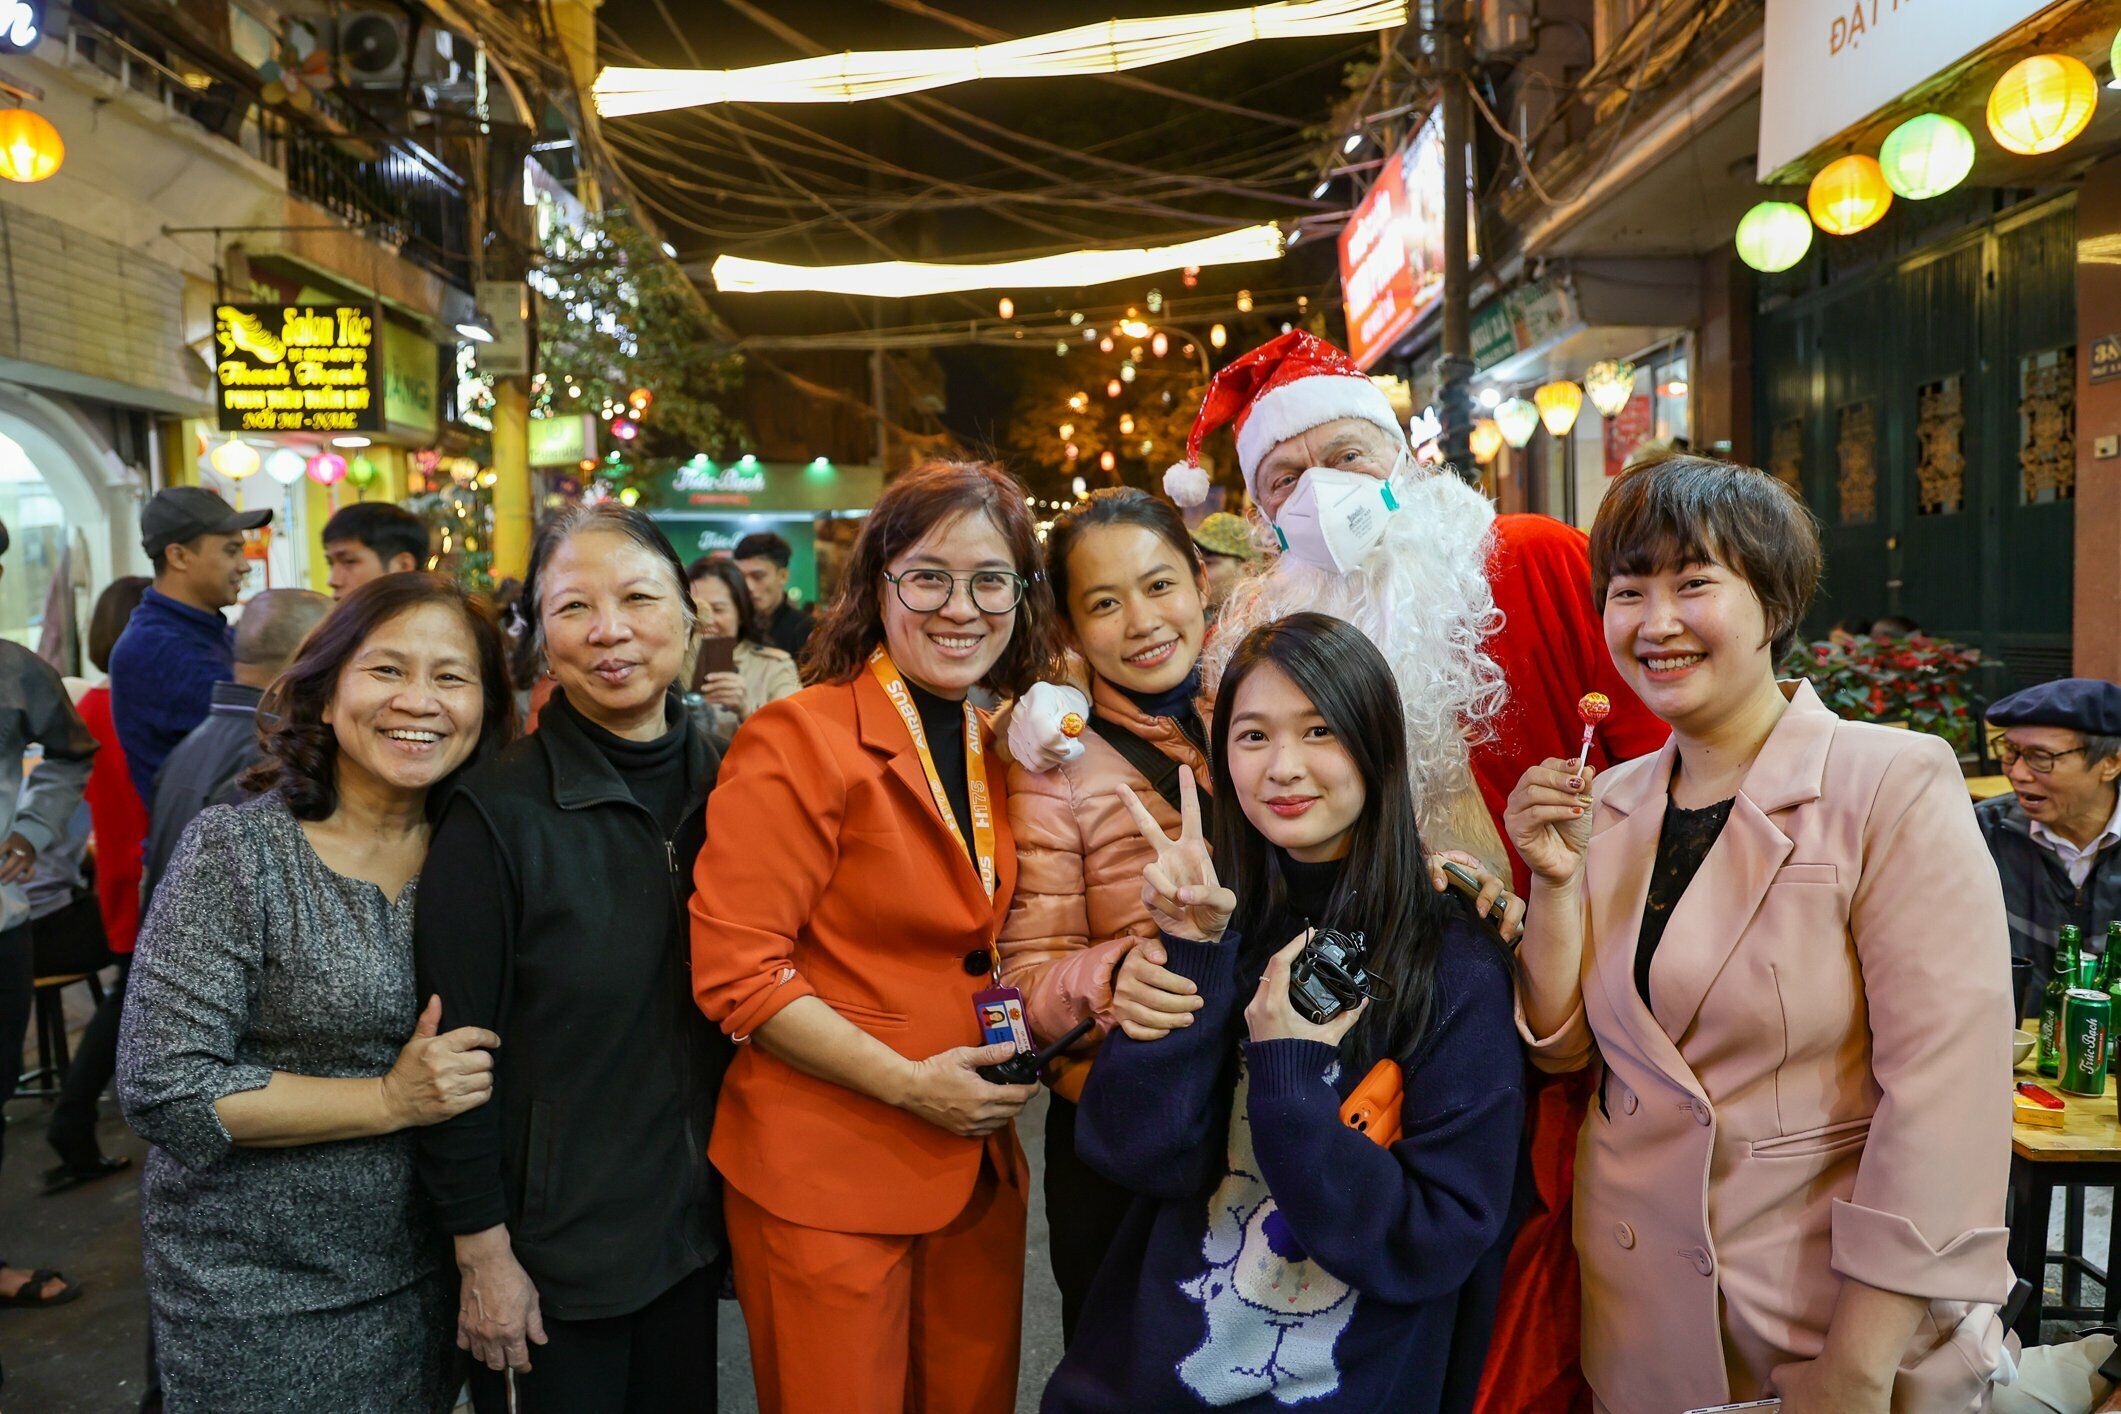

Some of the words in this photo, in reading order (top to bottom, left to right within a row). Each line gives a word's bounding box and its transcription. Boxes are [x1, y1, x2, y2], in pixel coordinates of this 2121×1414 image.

[886, 679, 926, 750] AIRBUS
[970, 780, 990, 828] H175
[2081, 1017, 2098, 1049] Bạch
[2078, 1046, 2095, 1075] Trúc
